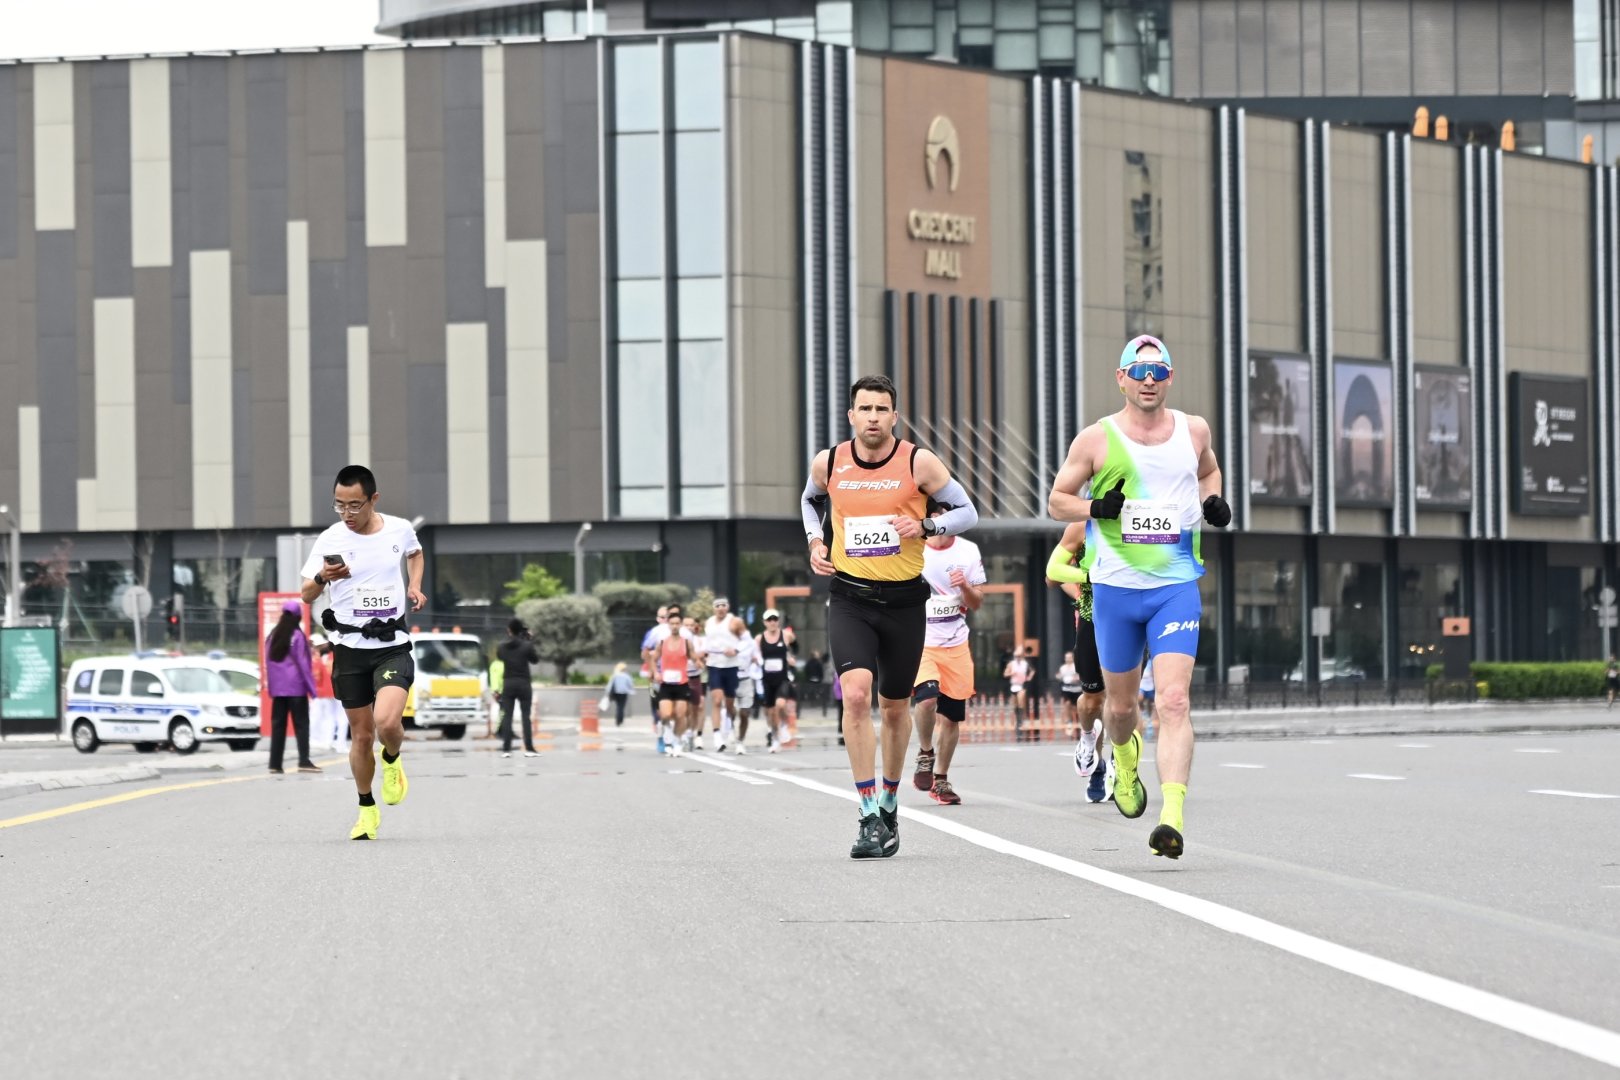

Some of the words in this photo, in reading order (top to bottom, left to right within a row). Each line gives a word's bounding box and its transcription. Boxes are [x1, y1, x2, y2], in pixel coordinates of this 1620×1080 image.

[907, 208, 975, 242] CRESCENT
[926, 249, 961, 278] MALL
[837, 479, 901, 490] ESPAÑA
[1132, 517, 1171, 530] 5436
[854, 531, 890, 545] 5624
[363, 596, 390, 607] 5315
